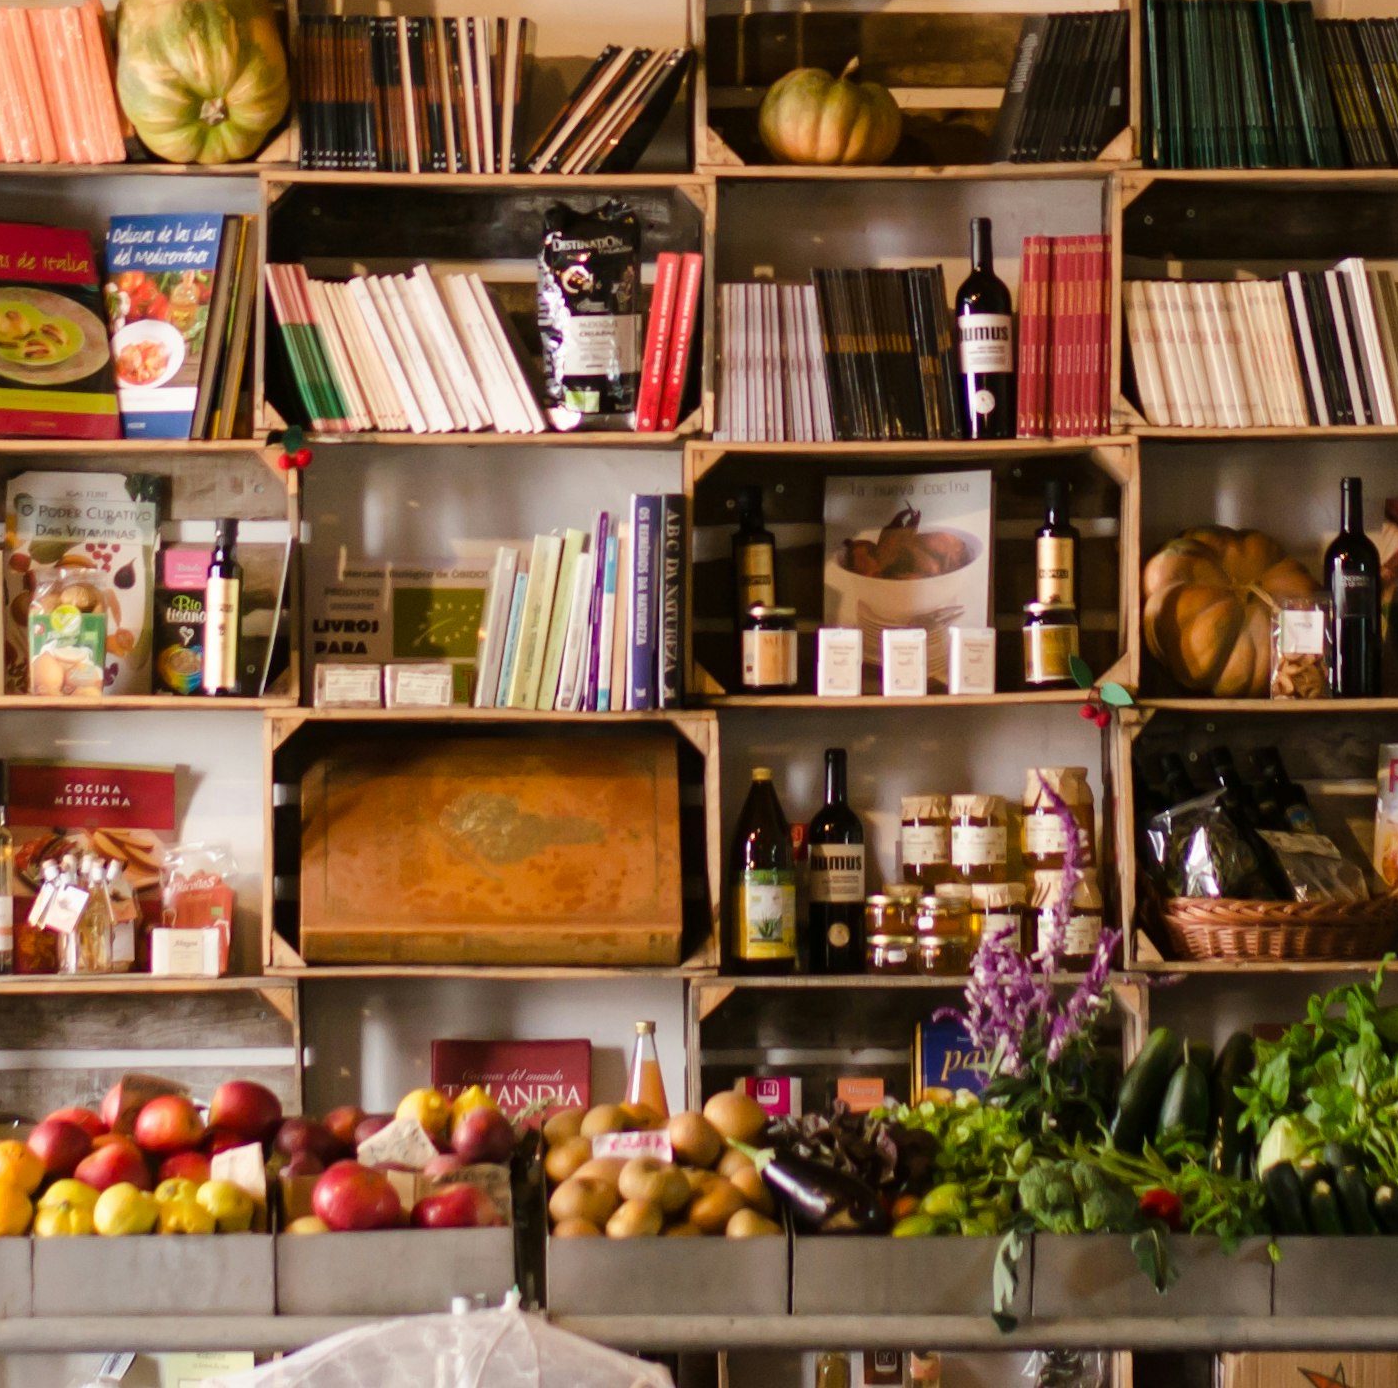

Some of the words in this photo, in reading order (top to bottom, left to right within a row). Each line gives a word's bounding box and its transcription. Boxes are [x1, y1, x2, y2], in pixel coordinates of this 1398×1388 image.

[111, 225, 154, 245] Delicias
[157, 224, 172, 244] de
[174, 222, 191, 242] las
[18, 248, 35, 270] de
[42, 253, 89, 274] Italia
[112, 247, 132, 266] del
[850, 479, 867, 497] la
[873, 481, 921, 497] nueva
[928, 478, 970, 496] cocina
[39, 505, 82, 518] PODER
[86, 506, 152, 522] CURATIVO
[638, 506, 650, 521] OS
[35, 523, 62, 537] DAS
[66, 524, 136, 540] VITAMINAS
[666, 507, 680, 552] ABC
[637, 523, 650, 574] REMÉDIOS
[666, 558, 680, 581] DA
[637, 576, 648, 591] DA
[172, 595, 203, 612] Bio
[311, 619, 379, 634] LIVROS
[636, 593, 648, 646] NATUREZA
[665, 583, 680, 674] NATUREZA
[314, 640, 368, 655] PARA
[64, 783, 121, 795] COCINA
[53, 796, 131, 807] MEXICANA
[506, 1068, 525, 1082] del
[525, 1069, 564, 1082] mundo
